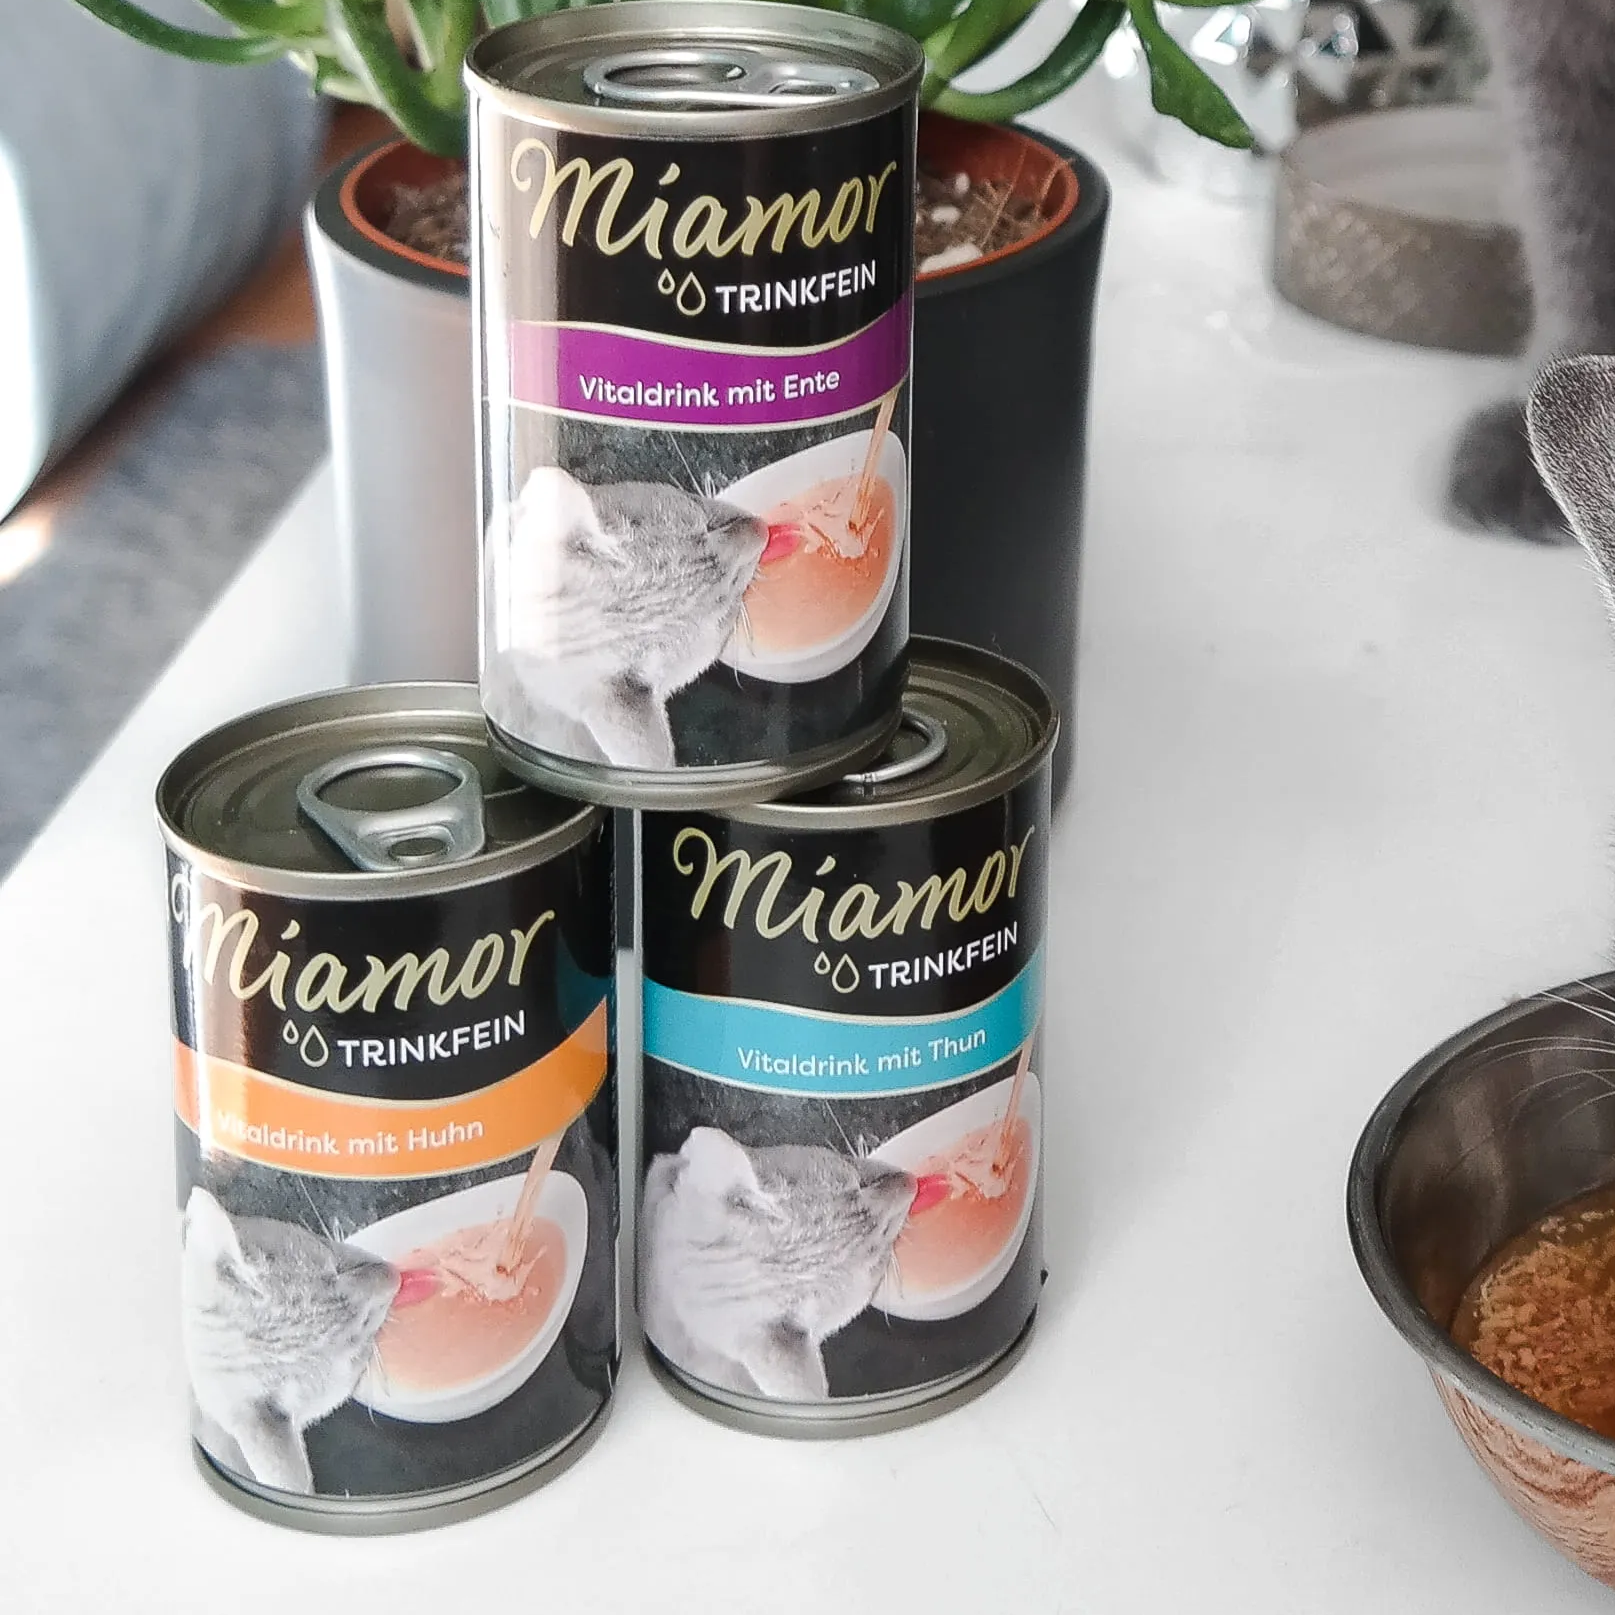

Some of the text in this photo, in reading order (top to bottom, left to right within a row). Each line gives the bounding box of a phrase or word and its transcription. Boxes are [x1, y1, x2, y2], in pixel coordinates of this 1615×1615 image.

[510, 138, 897, 260] Miamor
[715, 259, 877, 314] TRINKFEIN
[578, 369, 841, 408] Vitaldrink mit Ente
[674, 825, 1036, 943] Miamor
[171, 872, 555, 1014] Miamor
[868, 921, 1018, 990] TRINKFEIN
[337, 1009, 526, 1068] TRINKFEIN
[737, 1026, 986, 1076] Vitaldrink mit Thun
[217, 1108, 485, 1155] Vitaldrink mit Huhn
